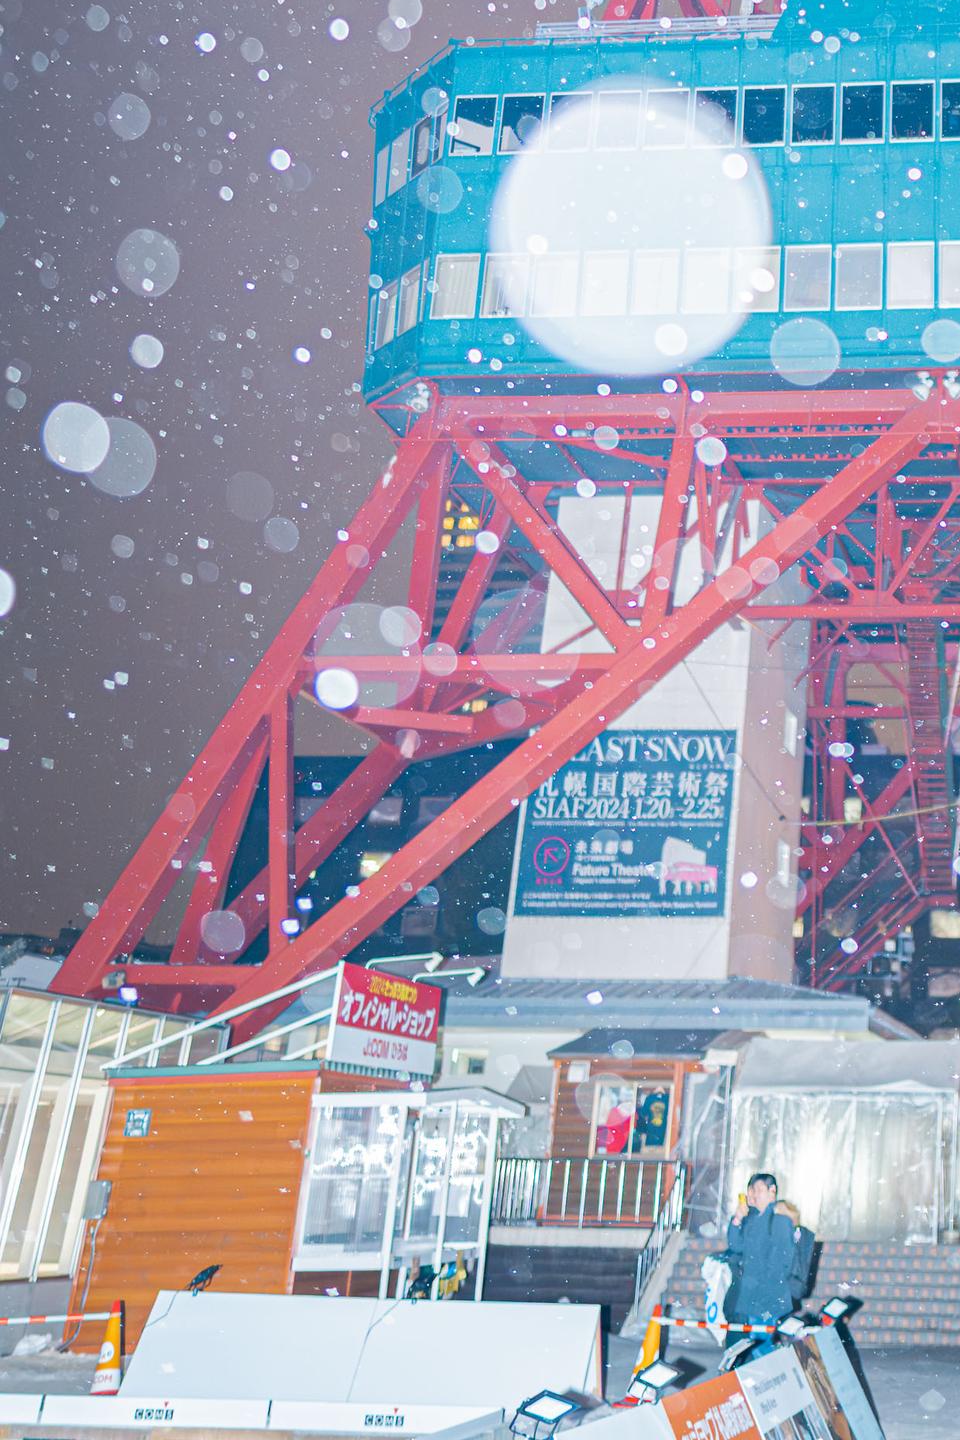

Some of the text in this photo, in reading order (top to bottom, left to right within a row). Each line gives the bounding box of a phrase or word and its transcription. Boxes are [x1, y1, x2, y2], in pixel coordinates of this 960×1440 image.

[571, 736, 734, 763] AST SNOW
[533, 797, 630, 820] SIAF2024
